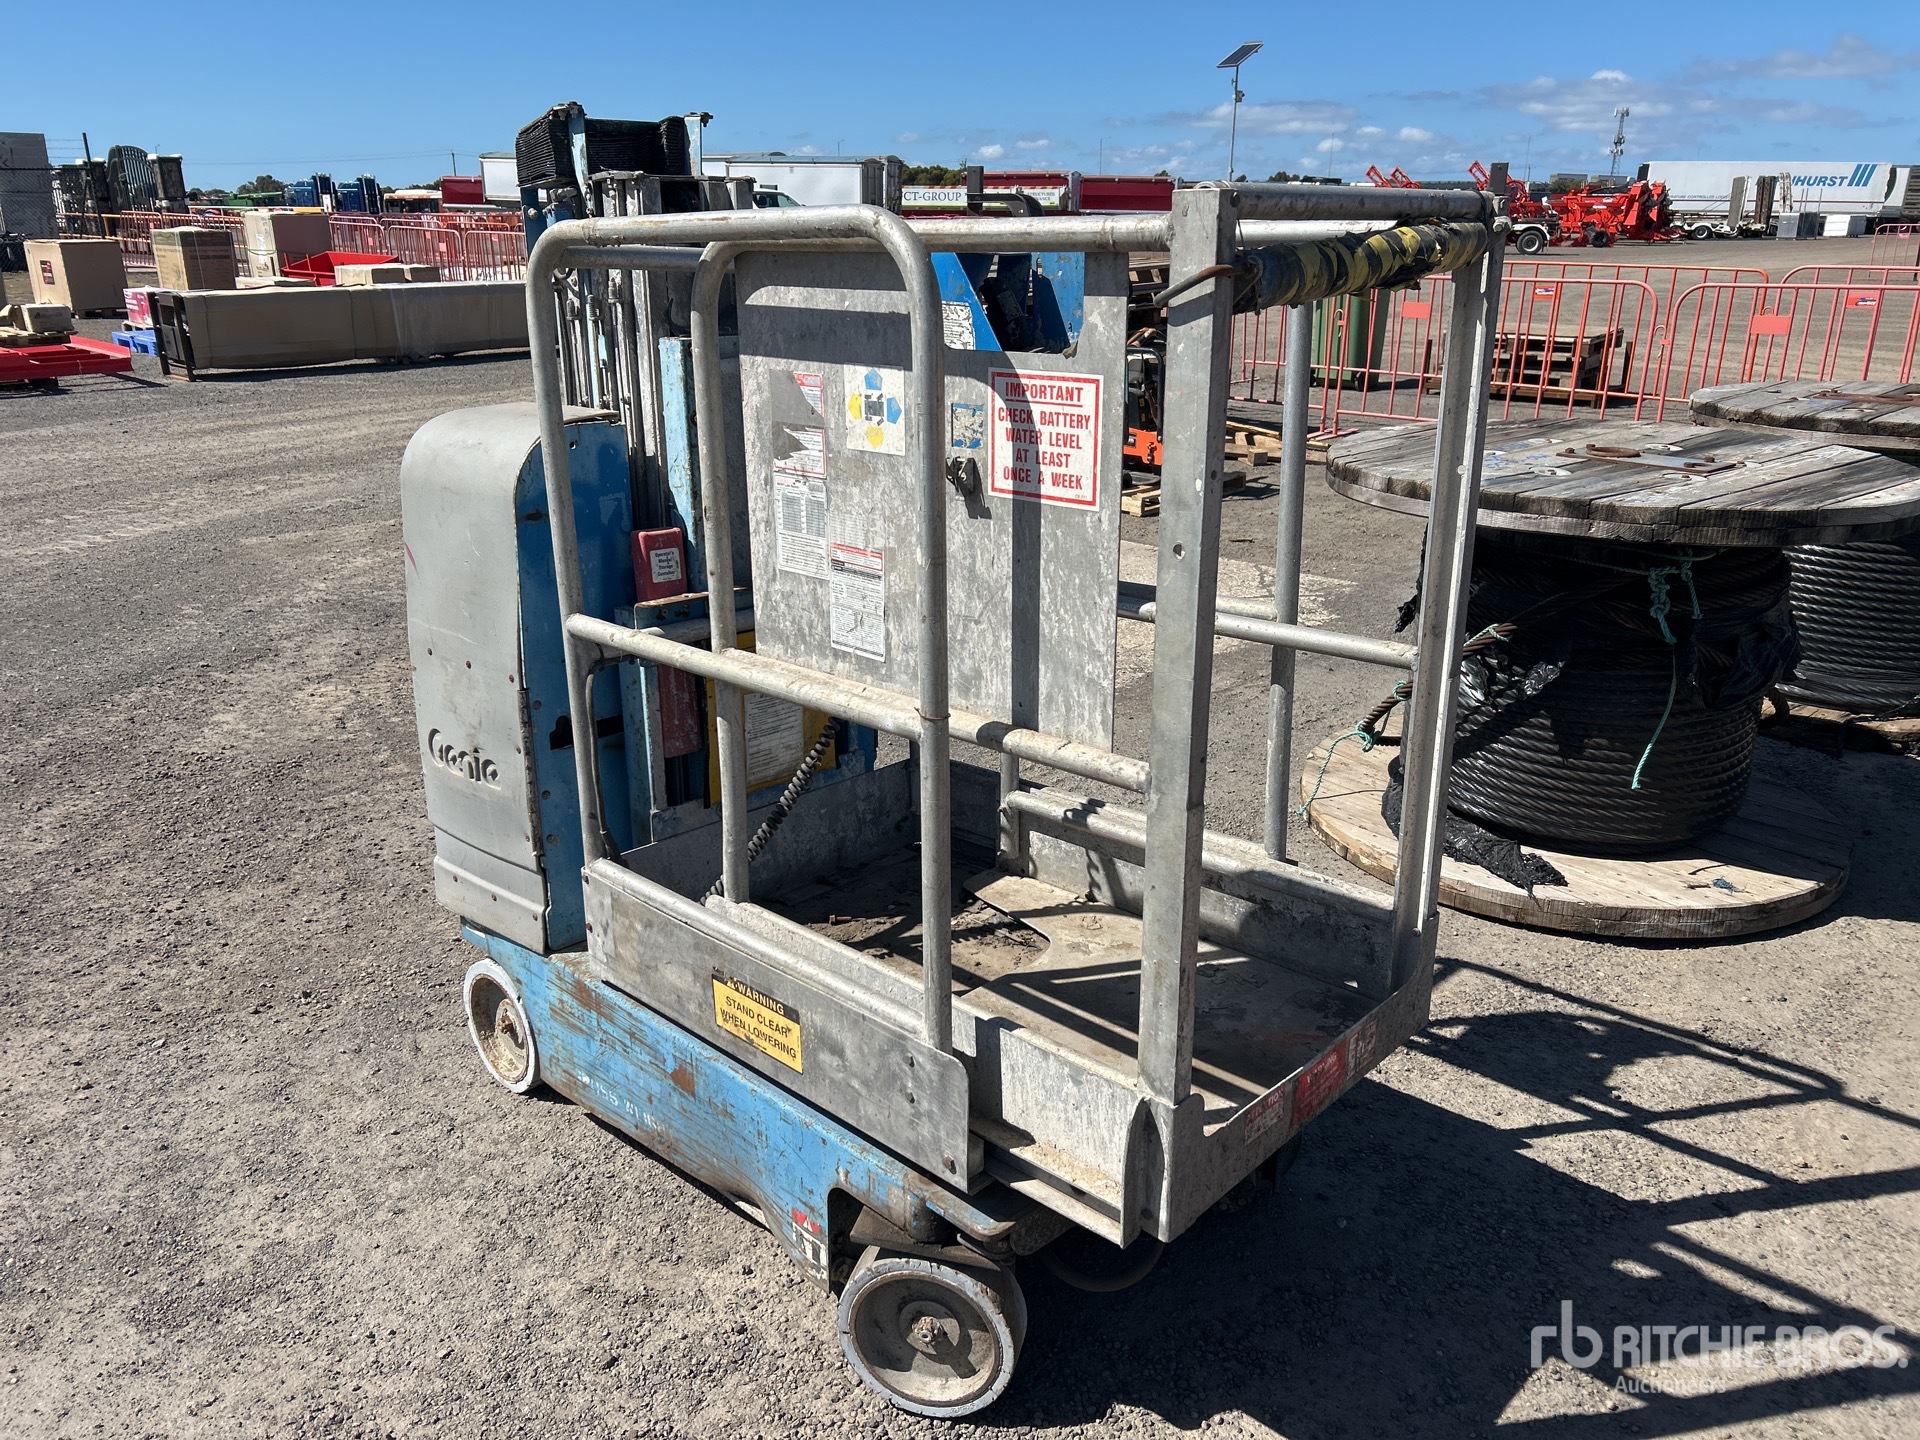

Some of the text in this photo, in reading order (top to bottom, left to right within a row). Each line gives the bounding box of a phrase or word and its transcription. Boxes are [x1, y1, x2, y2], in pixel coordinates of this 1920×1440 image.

[902, 191, 962, 202] CT-GROUP
[1005, 381, 1084, 403] IMPORTANT
[998, 406, 1091, 430] CHECK BATTERY
[1005, 427, 1082, 450] WATER LEVEL
[1015, 448, 1071, 468] AT LEAST
[1003, 465, 1083, 490] ONCE A WEEK
[737, 981, 785, 1015] WARNING
[725, 995, 789, 1039] STAND CLEAR
[720, 1007, 797, 1059] WHEN LOWERING
